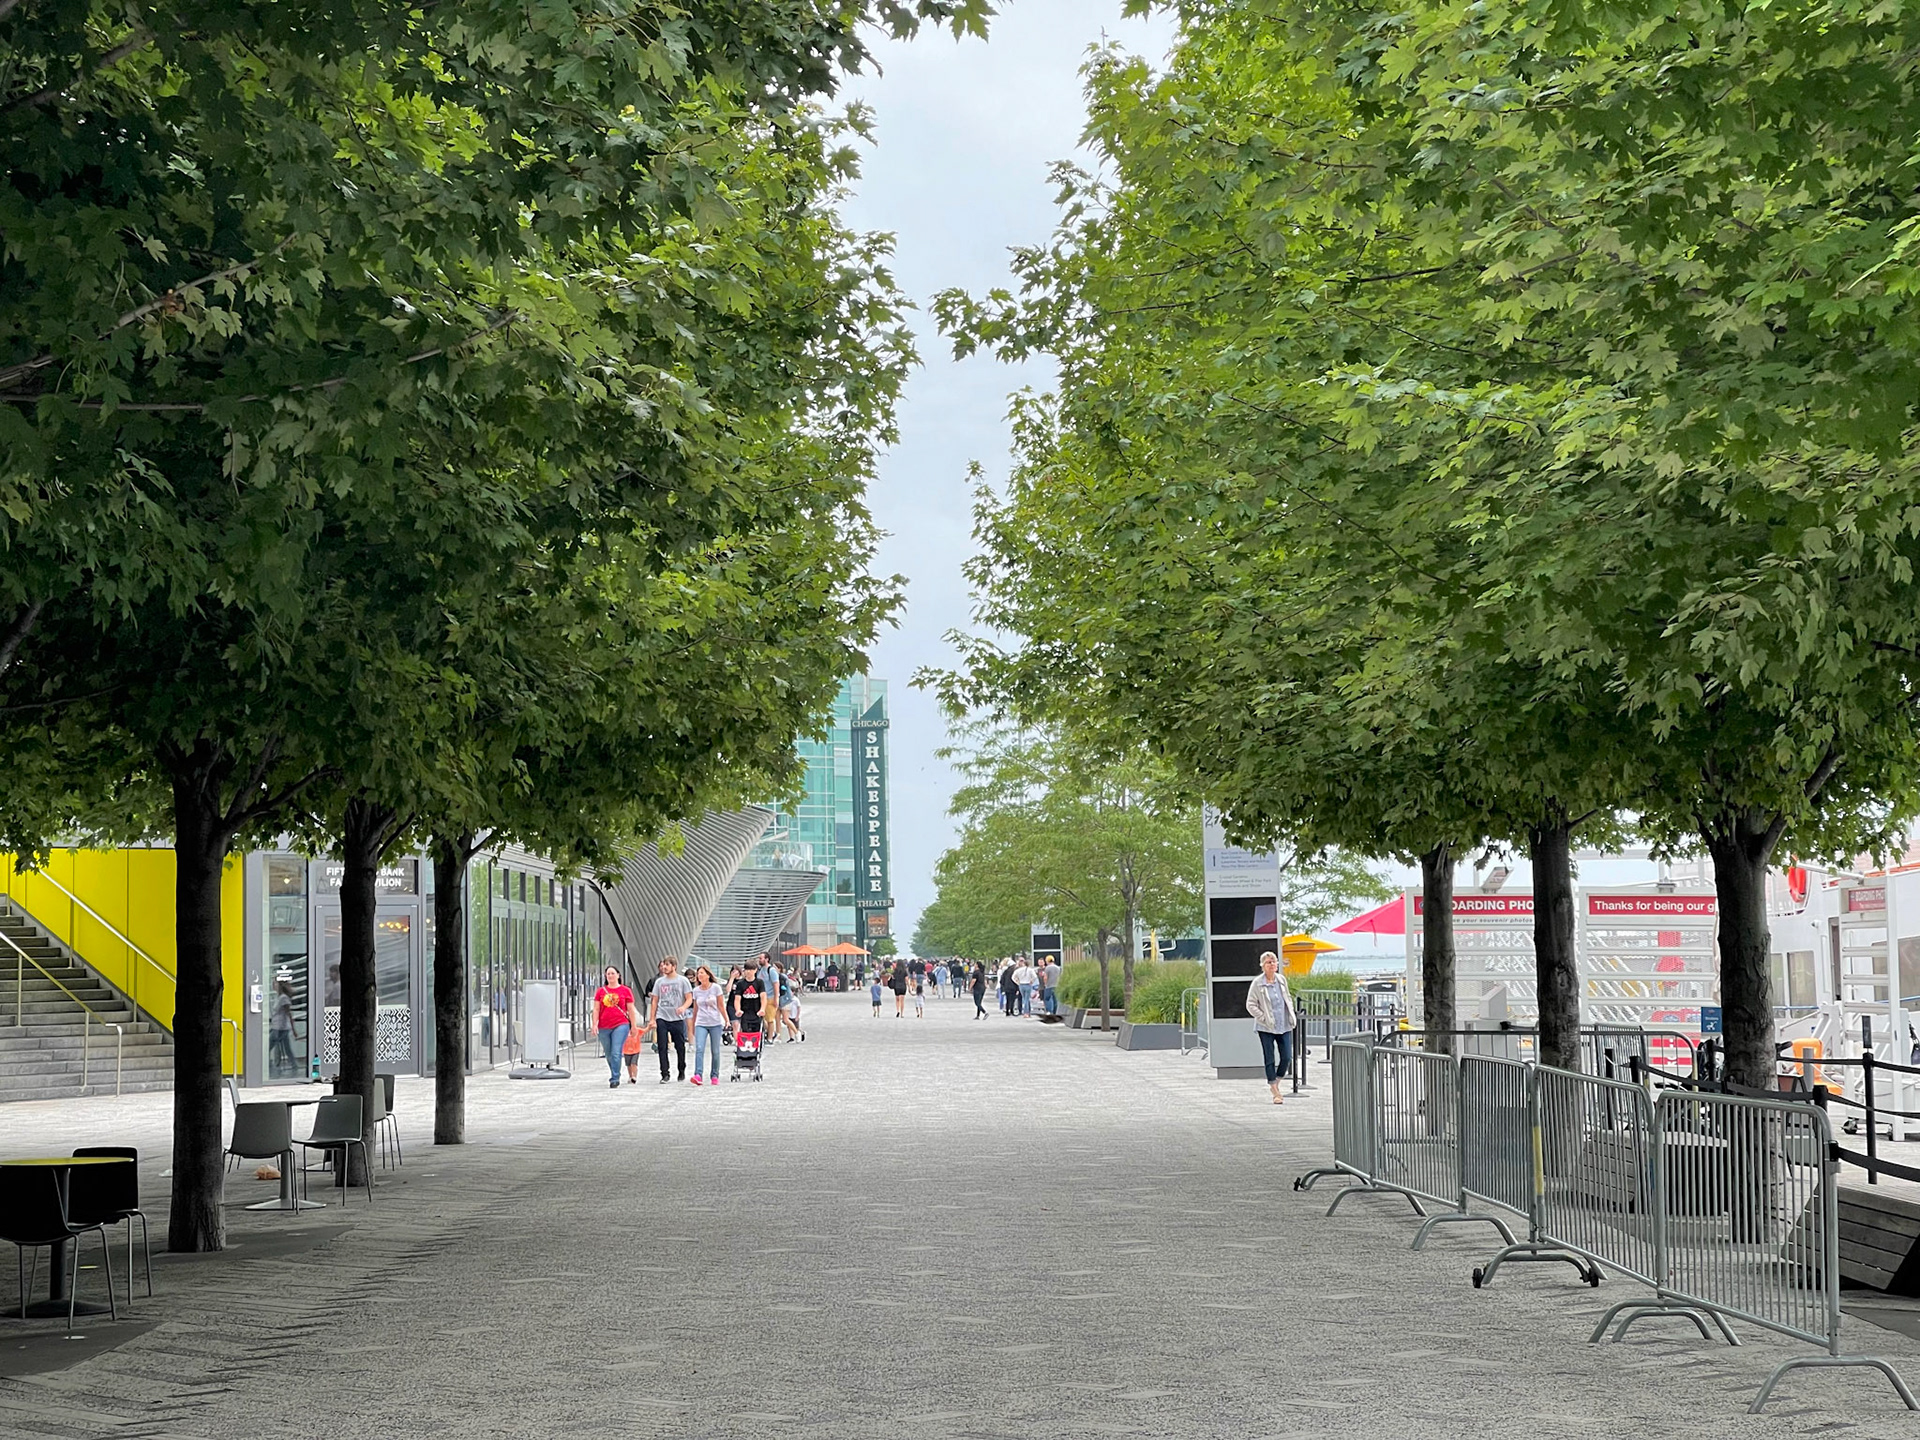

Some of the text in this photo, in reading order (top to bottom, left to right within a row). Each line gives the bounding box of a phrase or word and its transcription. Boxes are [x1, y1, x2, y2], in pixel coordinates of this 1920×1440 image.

[852, 720, 889, 728] CHICAGO
[865, 731, 882, 892] SHAKESPEARE
[326, 867, 345, 876] FIFT
[380, 867, 405, 876] BANK
[1509, 900, 1534, 910] PHO
[1594, 900, 1633, 910] Thanks
[1636, 900, 1650, 910] for
[1653, 901, 1684, 912] being
[1686, 903, 1704, 911] our
